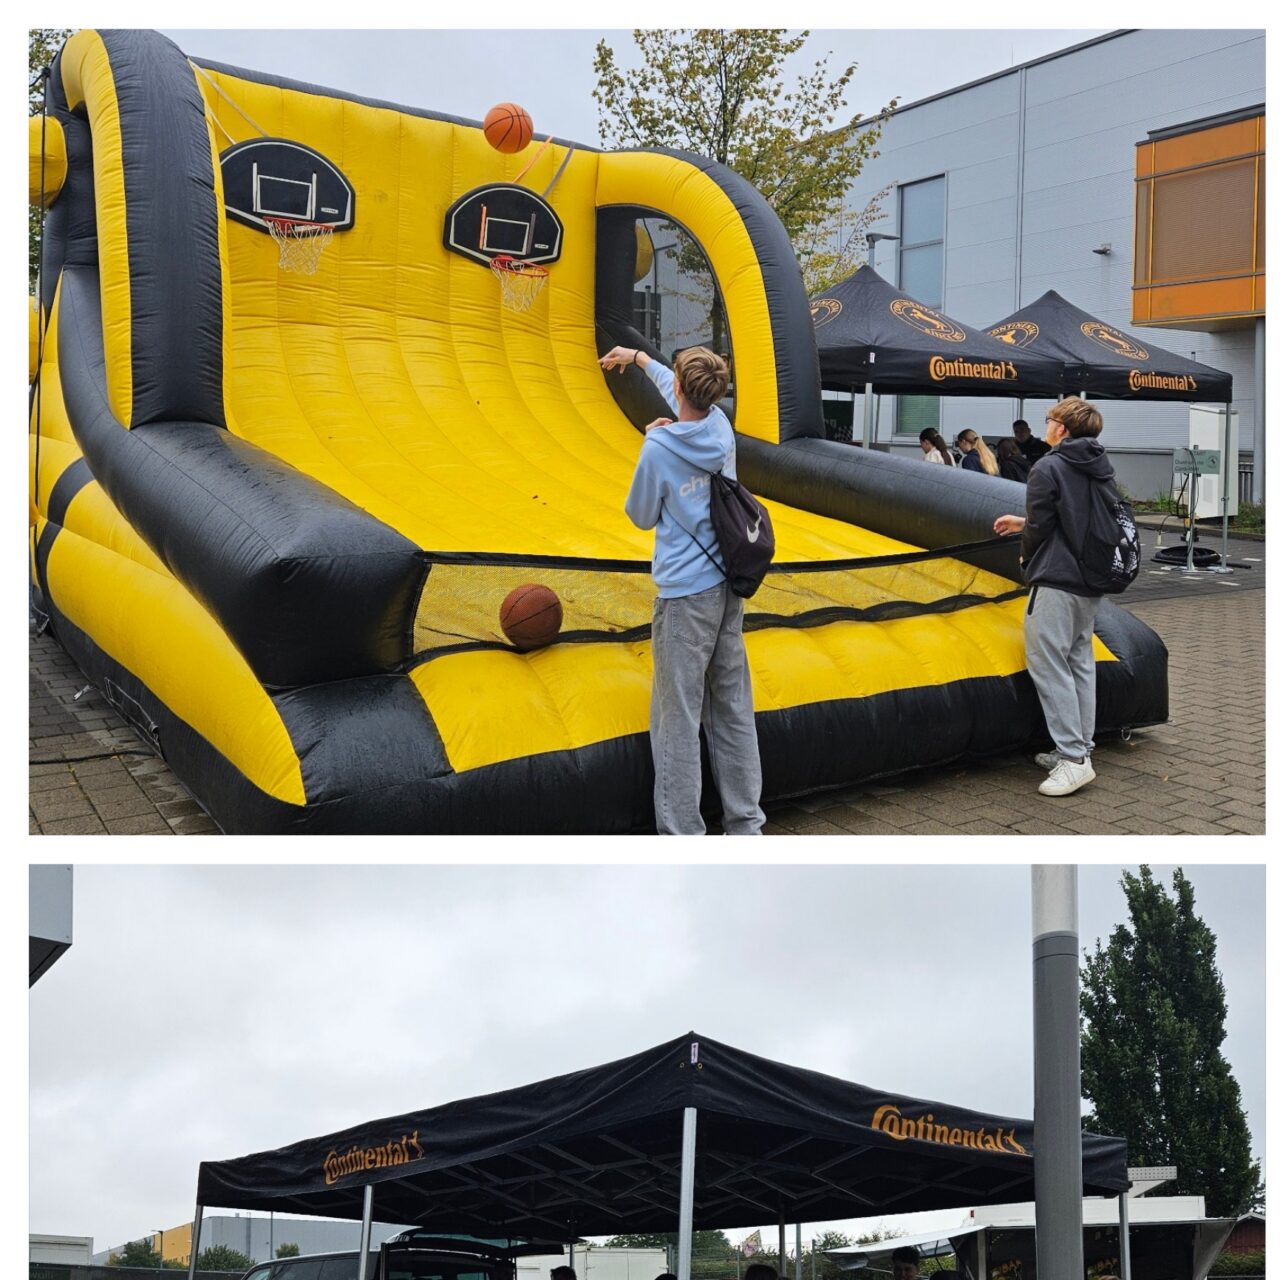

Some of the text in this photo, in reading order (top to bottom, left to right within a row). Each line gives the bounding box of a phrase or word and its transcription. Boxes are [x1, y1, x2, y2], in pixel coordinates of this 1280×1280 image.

[930, 356, 1005, 381] Continental
[1129, 370, 1188, 391] Continental
[872, 1105, 1007, 1152] Continental
[323, 1135, 410, 1185] Continental
